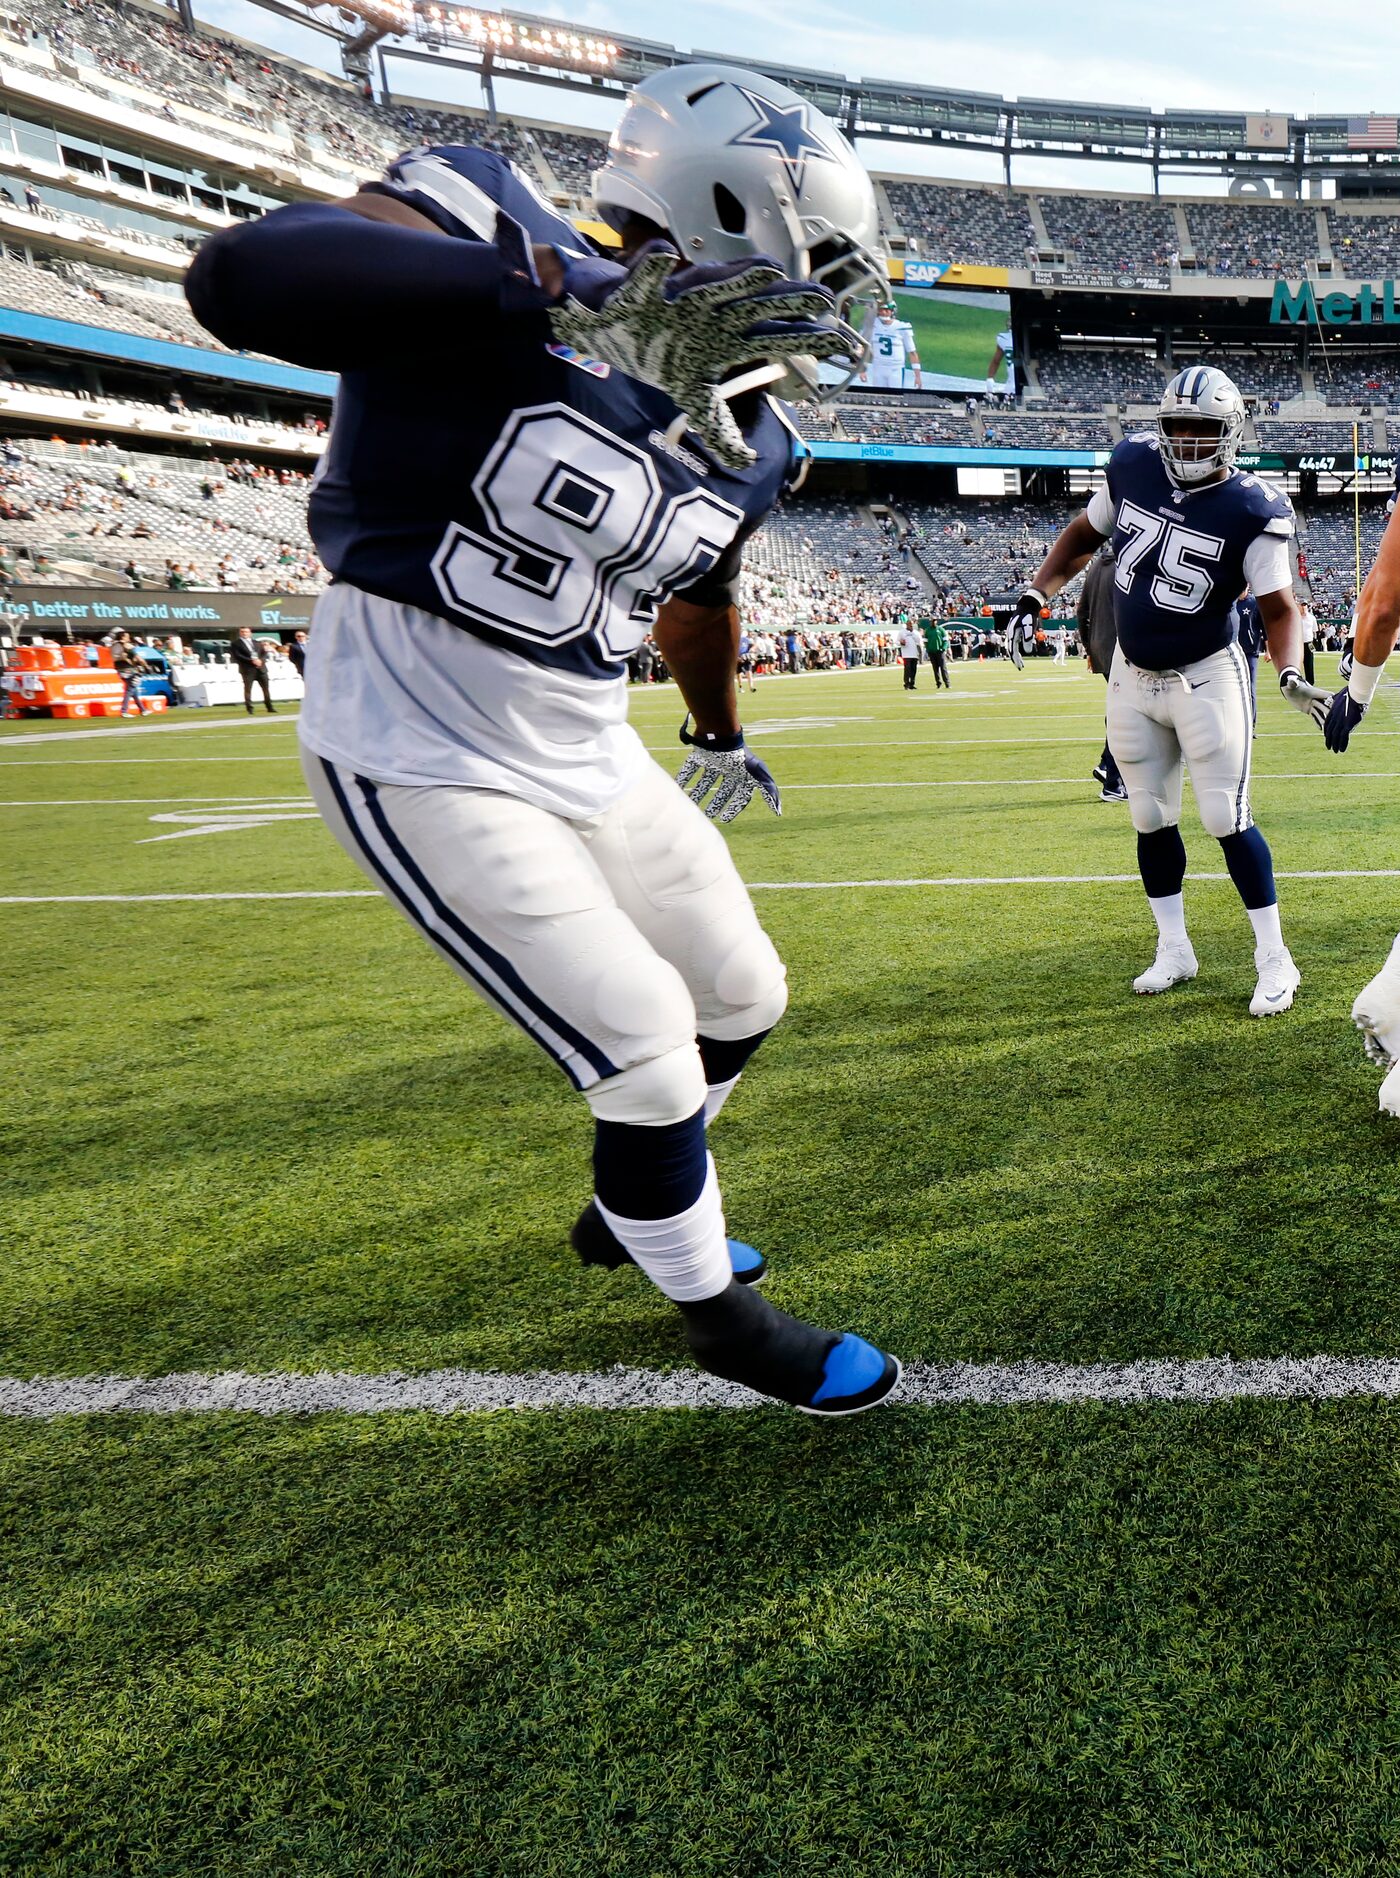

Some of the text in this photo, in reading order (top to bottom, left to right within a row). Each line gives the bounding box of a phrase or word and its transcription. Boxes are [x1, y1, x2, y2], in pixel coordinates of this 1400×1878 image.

[904, 264, 941, 282] SAP
[1035, 277, 1054, 285] Help?
[879, 337, 893, 356] 3
[862, 446, 894, 457] jetBlue
[1299, 457, 1336, 470] 44:47
[1371, 457, 1397, 468] Met
[1115, 498, 1226, 614] 75
[32, 600, 89, 617] better
[92, 602, 122, 618] the
[124, 604, 169, 619] world
[171, 605, 221, 620] works.
[260, 610, 280, 625] EY
[74, 705, 87, 716] G
[151, 702, 163, 712] G
